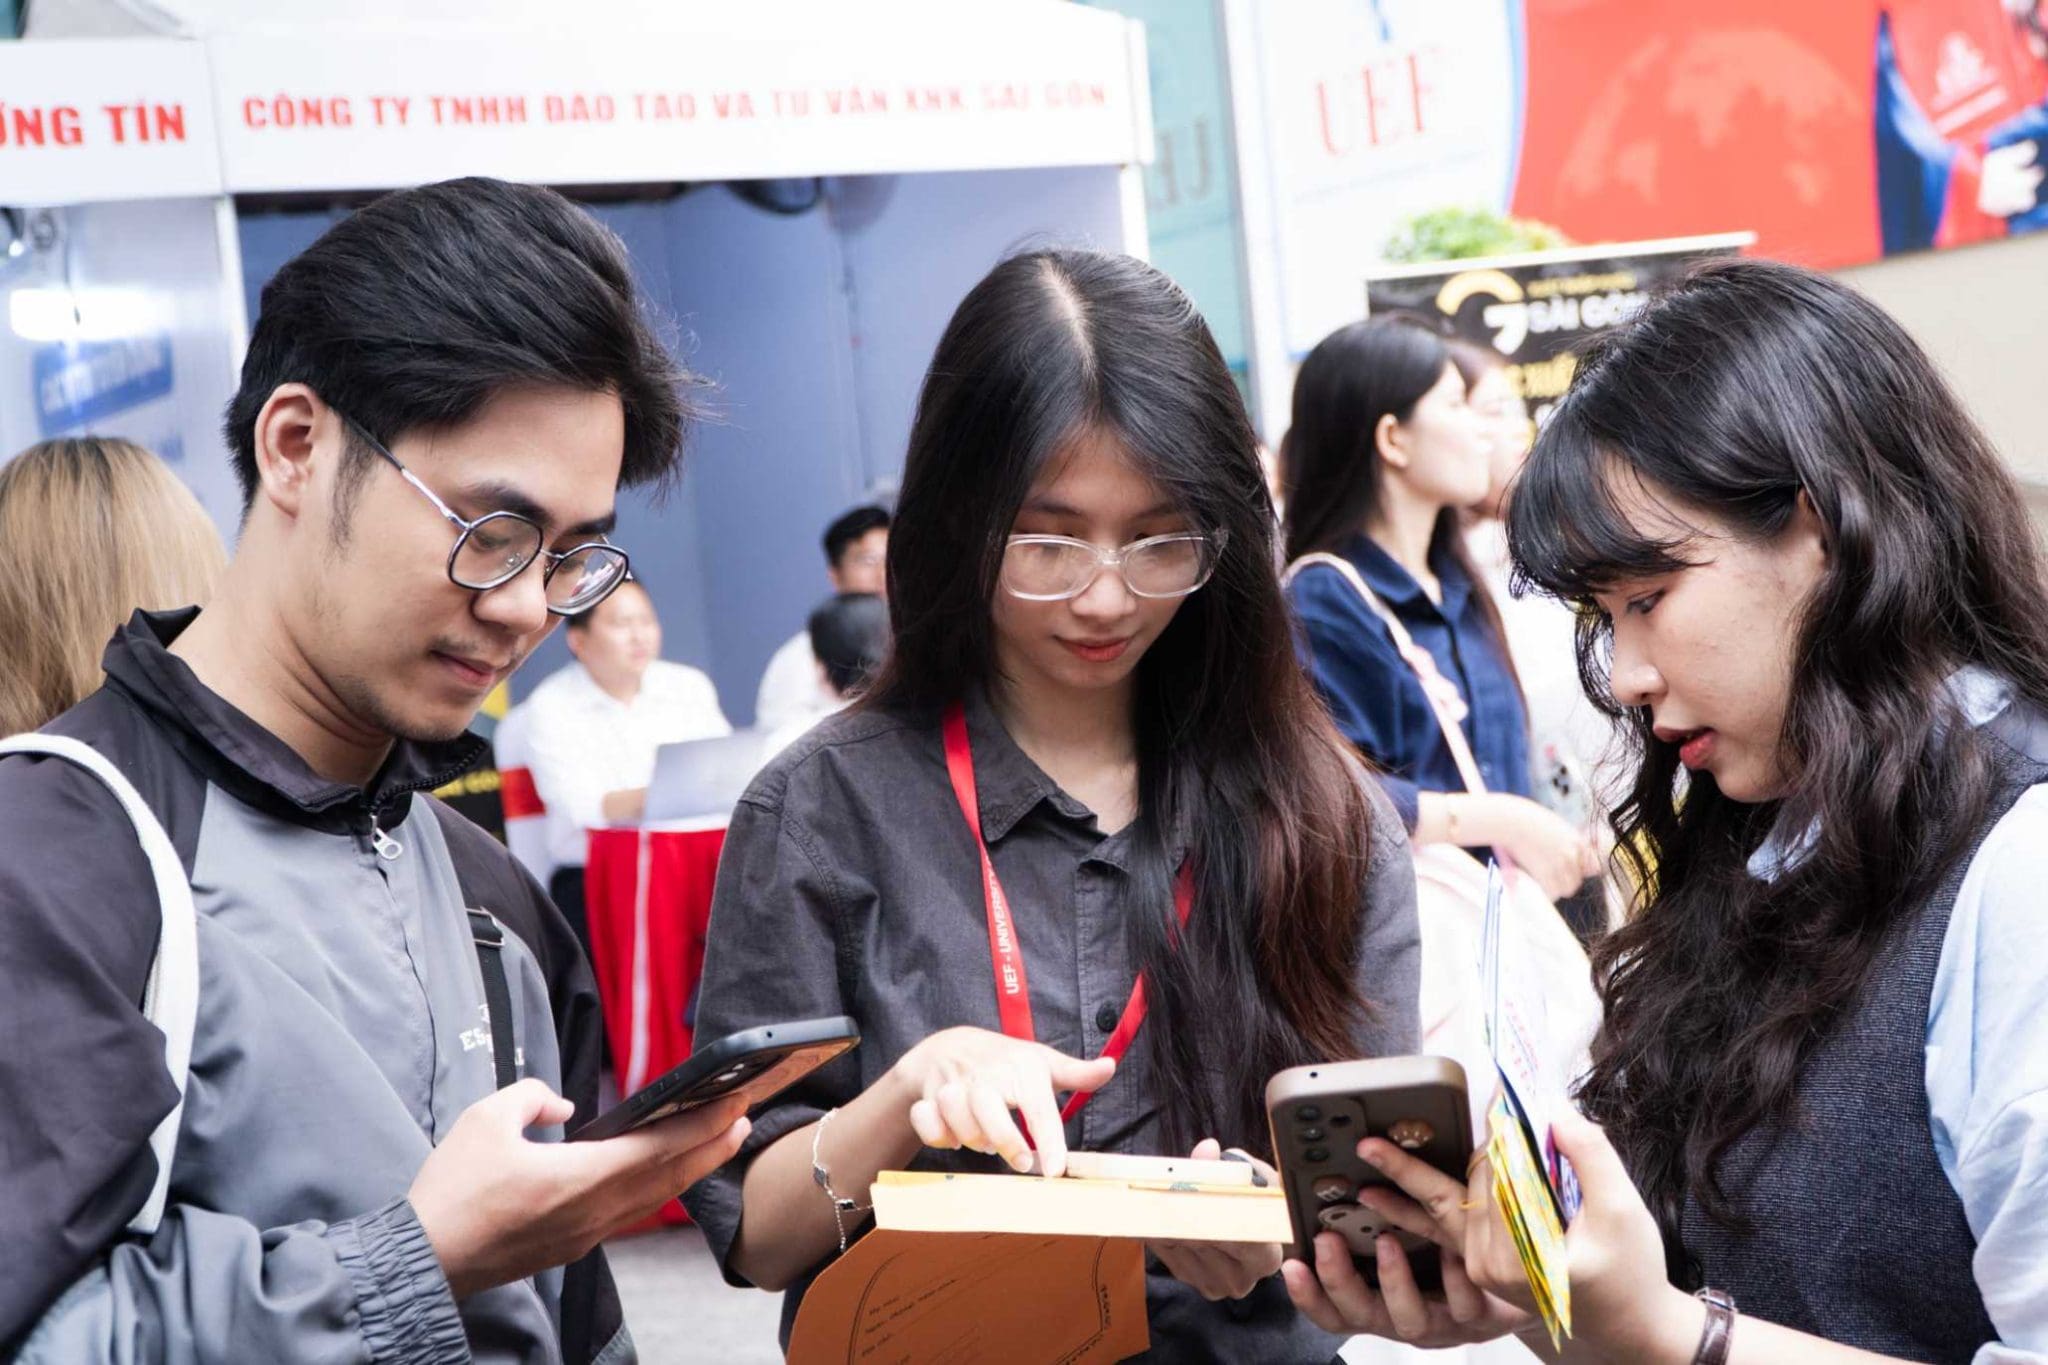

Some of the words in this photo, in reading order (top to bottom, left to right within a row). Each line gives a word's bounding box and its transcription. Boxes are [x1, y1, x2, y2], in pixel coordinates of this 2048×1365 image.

[0, 100, 83, 145] NG
[243, 91, 354, 129] CÔNG
[369, 95, 411, 127] TY
[429, 94, 528, 126] TNHH
[1316, 47, 1447, 159] UEF
[1002, 963, 1020, 994] UEF
